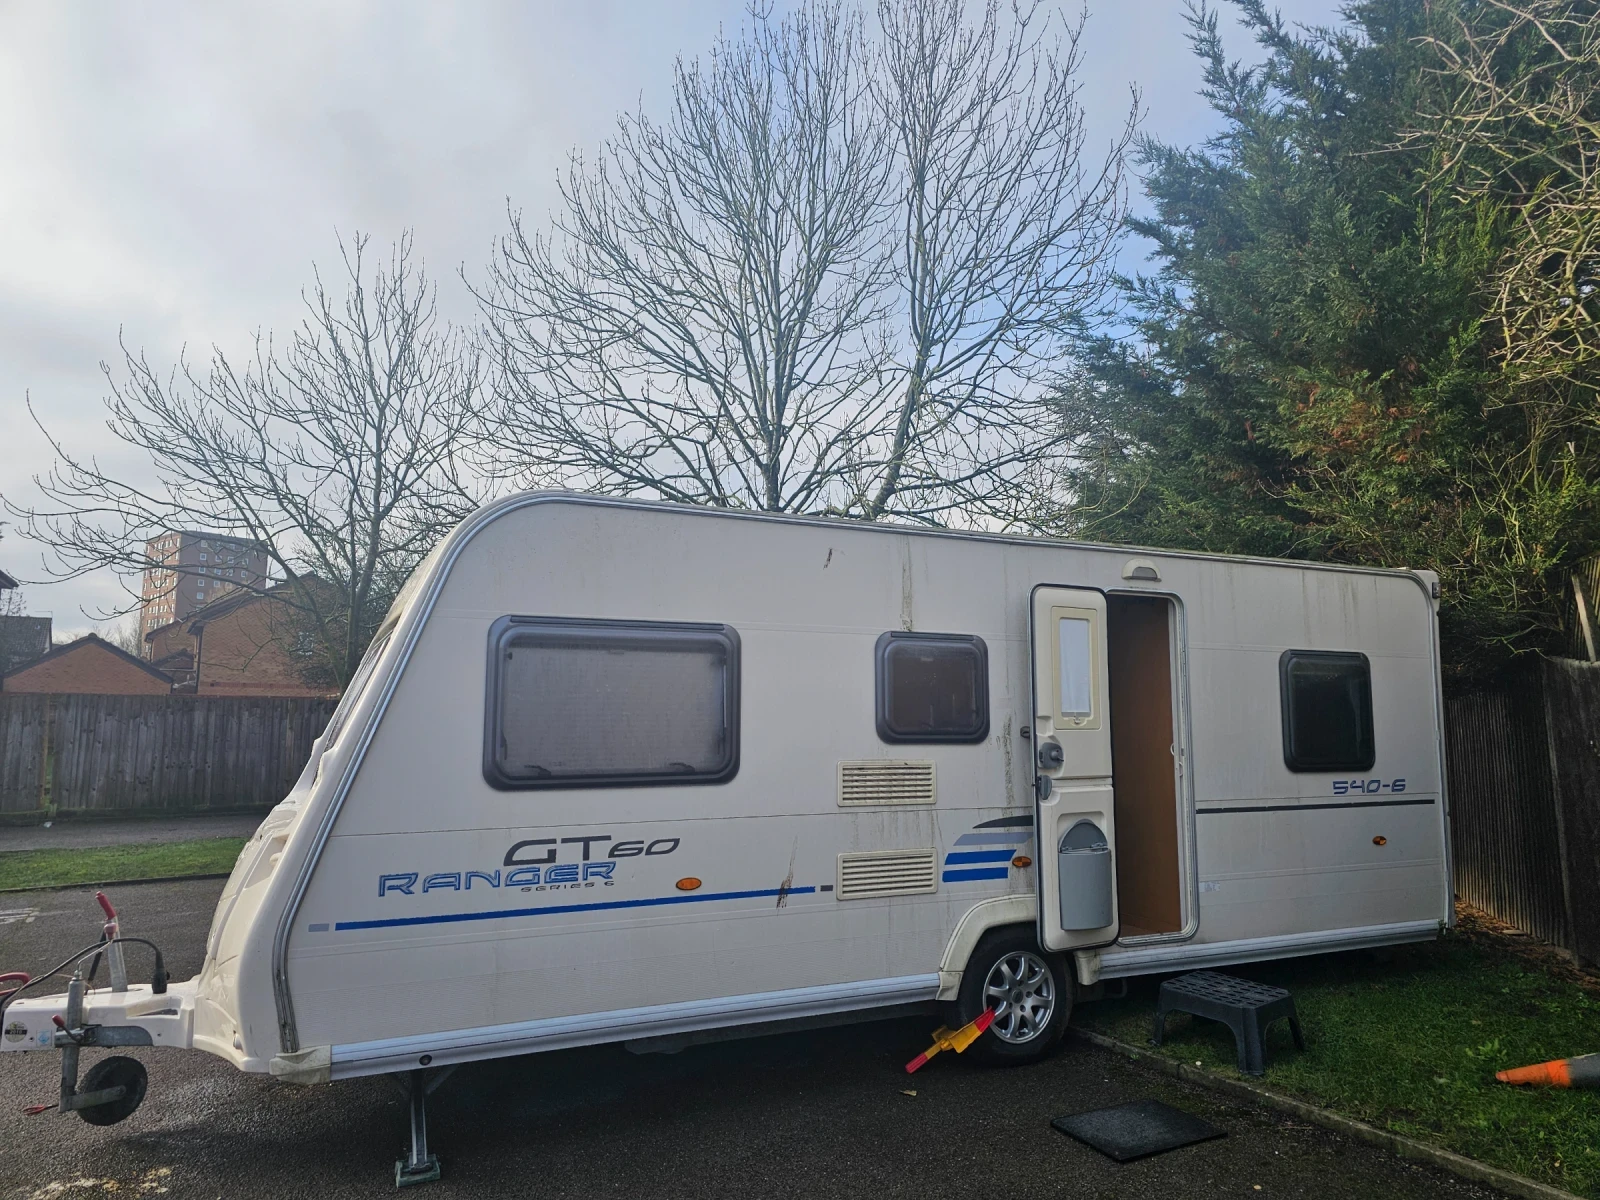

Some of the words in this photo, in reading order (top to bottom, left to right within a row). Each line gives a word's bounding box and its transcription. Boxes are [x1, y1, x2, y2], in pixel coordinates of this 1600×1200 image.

[1332, 778, 1406, 795] 540-6
[378, 861, 617, 897] RANGER
[521, 882, 595, 893] SERIES
